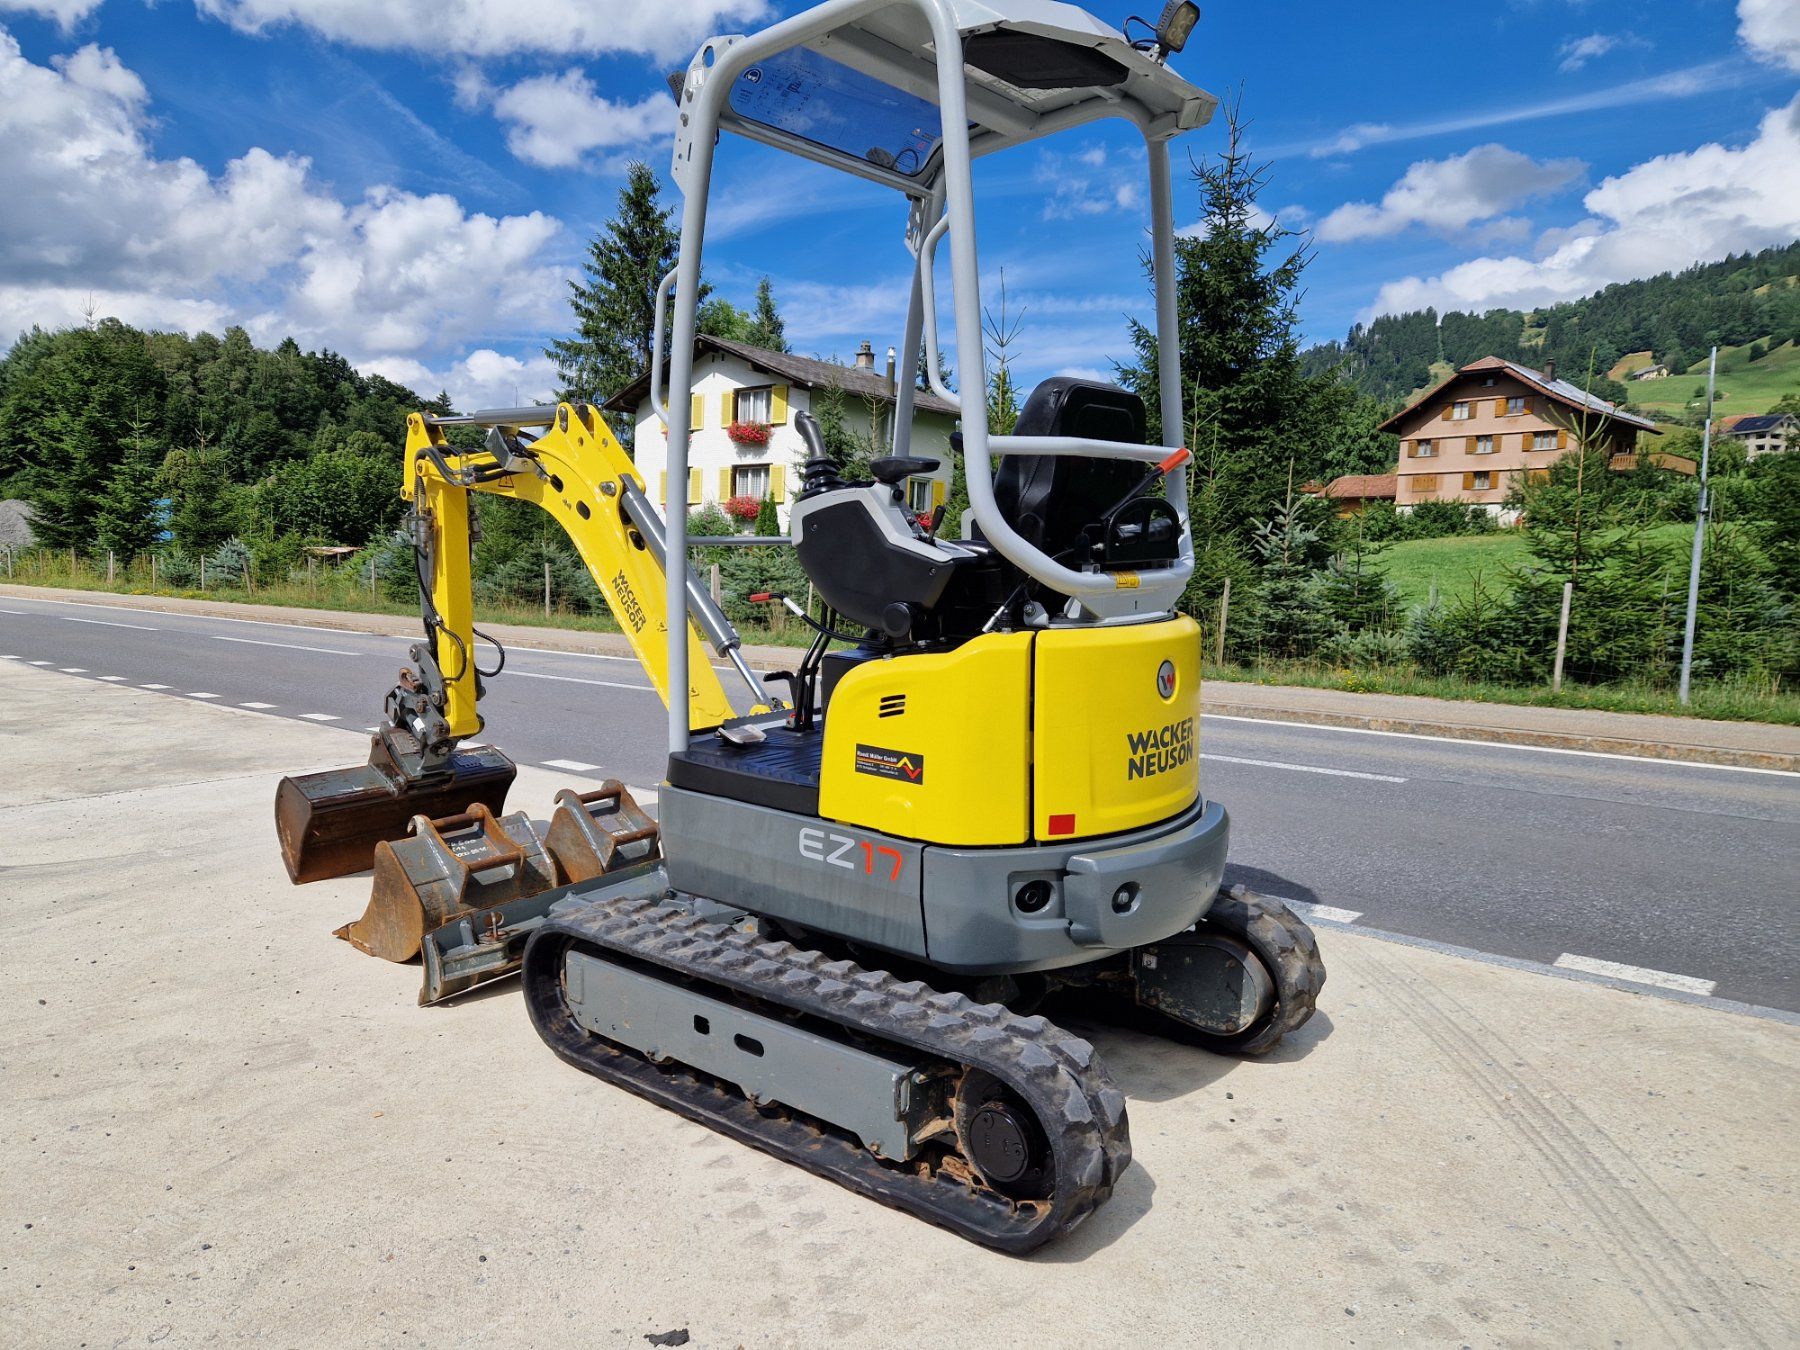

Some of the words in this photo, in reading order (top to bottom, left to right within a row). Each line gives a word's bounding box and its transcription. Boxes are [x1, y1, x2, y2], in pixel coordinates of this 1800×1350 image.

[612, 576, 641, 633] NEUSON
[618, 568, 646, 627] WACKER
[1127, 717, 1193, 755] WACKER
[1128, 740, 1193, 780] NEUSON
